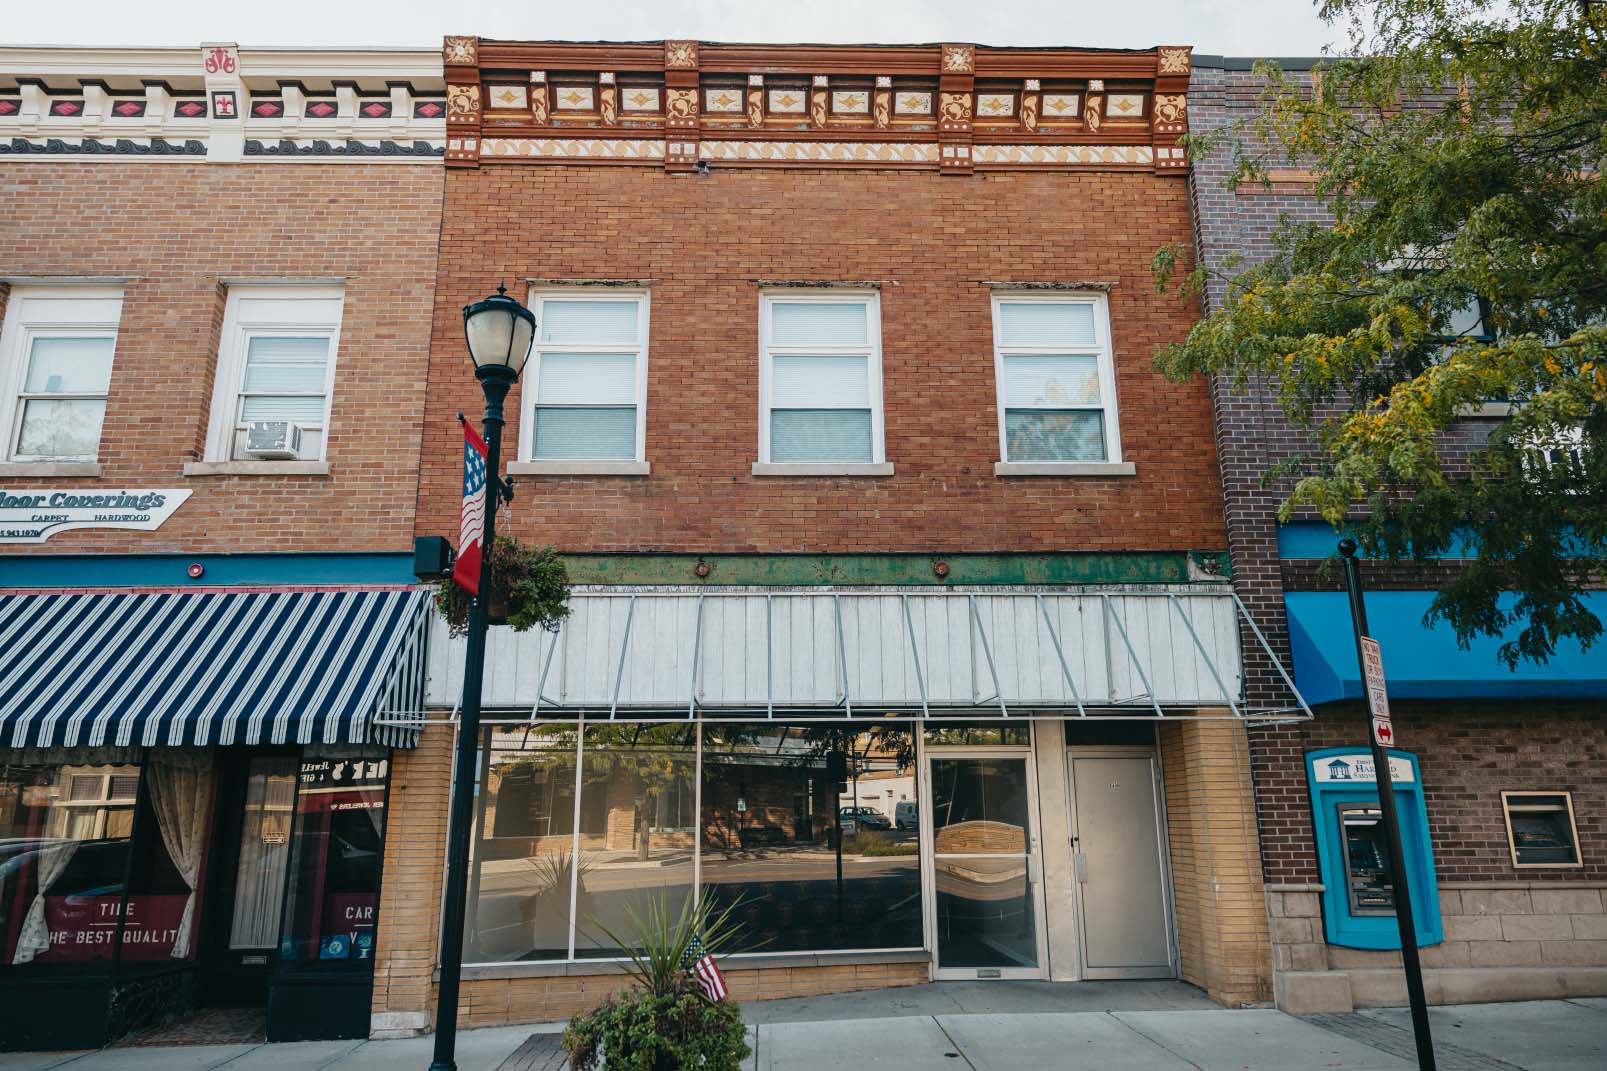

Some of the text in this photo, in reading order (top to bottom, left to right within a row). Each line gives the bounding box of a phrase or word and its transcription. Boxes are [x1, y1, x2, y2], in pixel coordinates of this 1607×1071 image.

[0, 491, 46, 508] loor
[49, 929, 178, 944] HE BEST QUALIT
